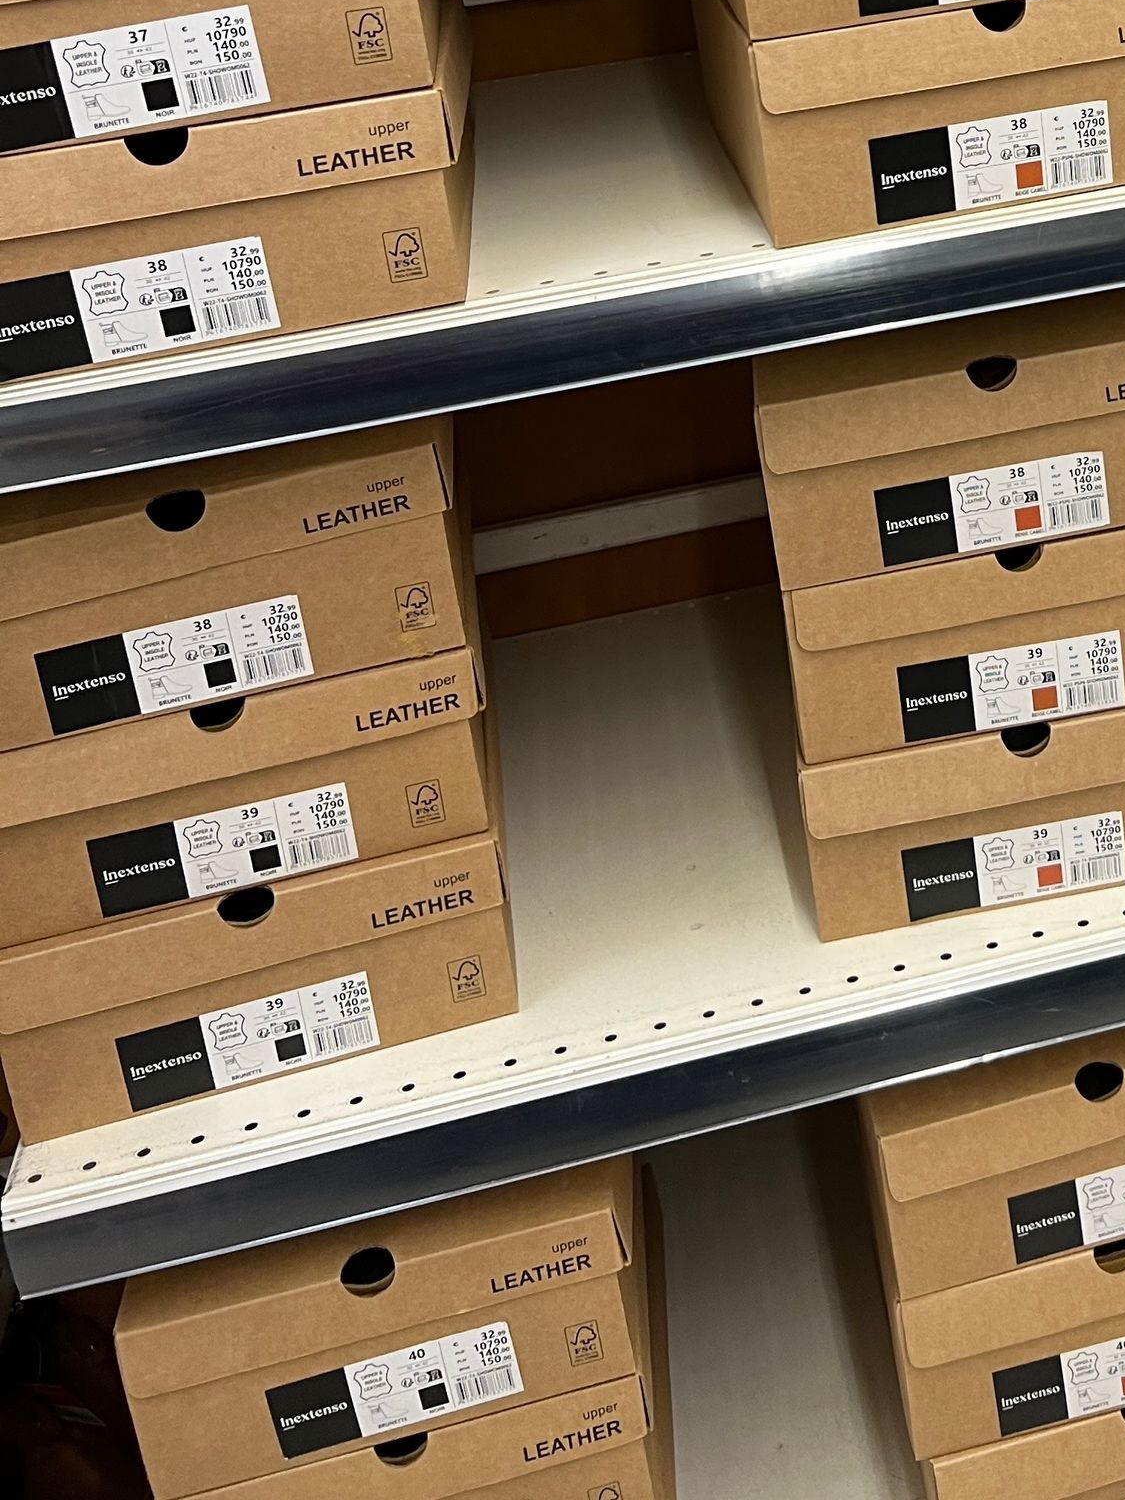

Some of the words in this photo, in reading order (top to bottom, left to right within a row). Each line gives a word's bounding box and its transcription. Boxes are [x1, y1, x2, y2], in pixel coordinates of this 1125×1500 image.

[369, 121, 409, 137] upper
[1011, 118, 1027, 130] 38
[1072, 117, 1105, 131] 10790
[297, 142, 418, 178] LEATHER
[881, 167, 946, 185] Inextenso
[148, 260, 167, 273] 38
[1, 315, 74, 337] nextenso
[1010, 467, 1024, 479] 38
[367, 477, 404, 492] upper
[303, 495, 410, 533] LEATHER
[886, 513, 948, 533] Inextenso
[194, 619, 211, 632] 38
[1028, 648, 1042, 659] 39
[53, 672, 125, 700] Inextenso
[906, 691, 967, 710] Inextenso
[356, 694, 460, 733] LEATHER
[242, 808, 258, 819] 39
[103, 858, 175, 883] Inextenso
[434, 872, 469, 888] upper
[913, 870, 973, 890] Inextenso
[372, 890, 474, 928] LEATHER
[266, 999, 283, 1011] 39
[131, 1052, 201, 1080] Inextenso
[552, 1237, 587, 1253] upper
[491, 1255, 591, 1293] LEATHER
[473, 1337, 507, 1352] 10790
[409, 1349, 425, 1360] 40
[1002, 1386, 1060, 1409] Inextenso
[280, 1402, 347, 1430] Inextenso
[523, 1421, 621, 1462] LEATHER
